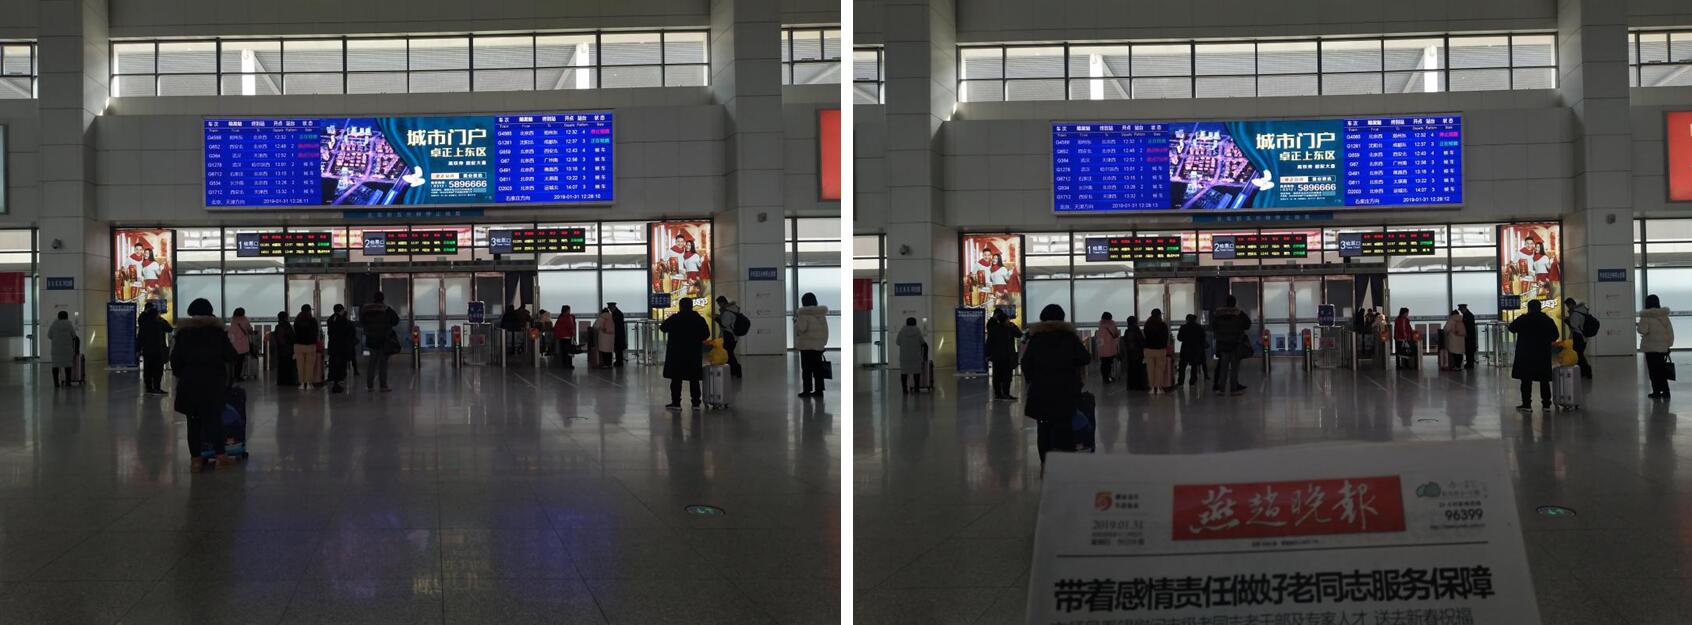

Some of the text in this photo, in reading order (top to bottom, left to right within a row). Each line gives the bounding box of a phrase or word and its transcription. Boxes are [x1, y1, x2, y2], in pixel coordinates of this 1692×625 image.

[407, 128, 486, 146] 城市门户
[1256, 132, 1335, 150] 城市门户
[431, 147, 486, 157] 卓正上东区
[1279, 150, 1335, 160] 卓正上东区
[239, 241, 241, 249] 1
[364, 239, 369, 248] 2
[491, 238, 496, 246] 3
[1340, 241, 1346, 249] 3
[1087, 246, 1091, 254] 1
[1214, 243, 1219, 252] 2
[1444, 508, 1484, 521] 96399
[1092, 520, 1144, 530] 2019.01.31
[1054, 564, 1495, 613] 带着感情责任做好老同志服务保障
